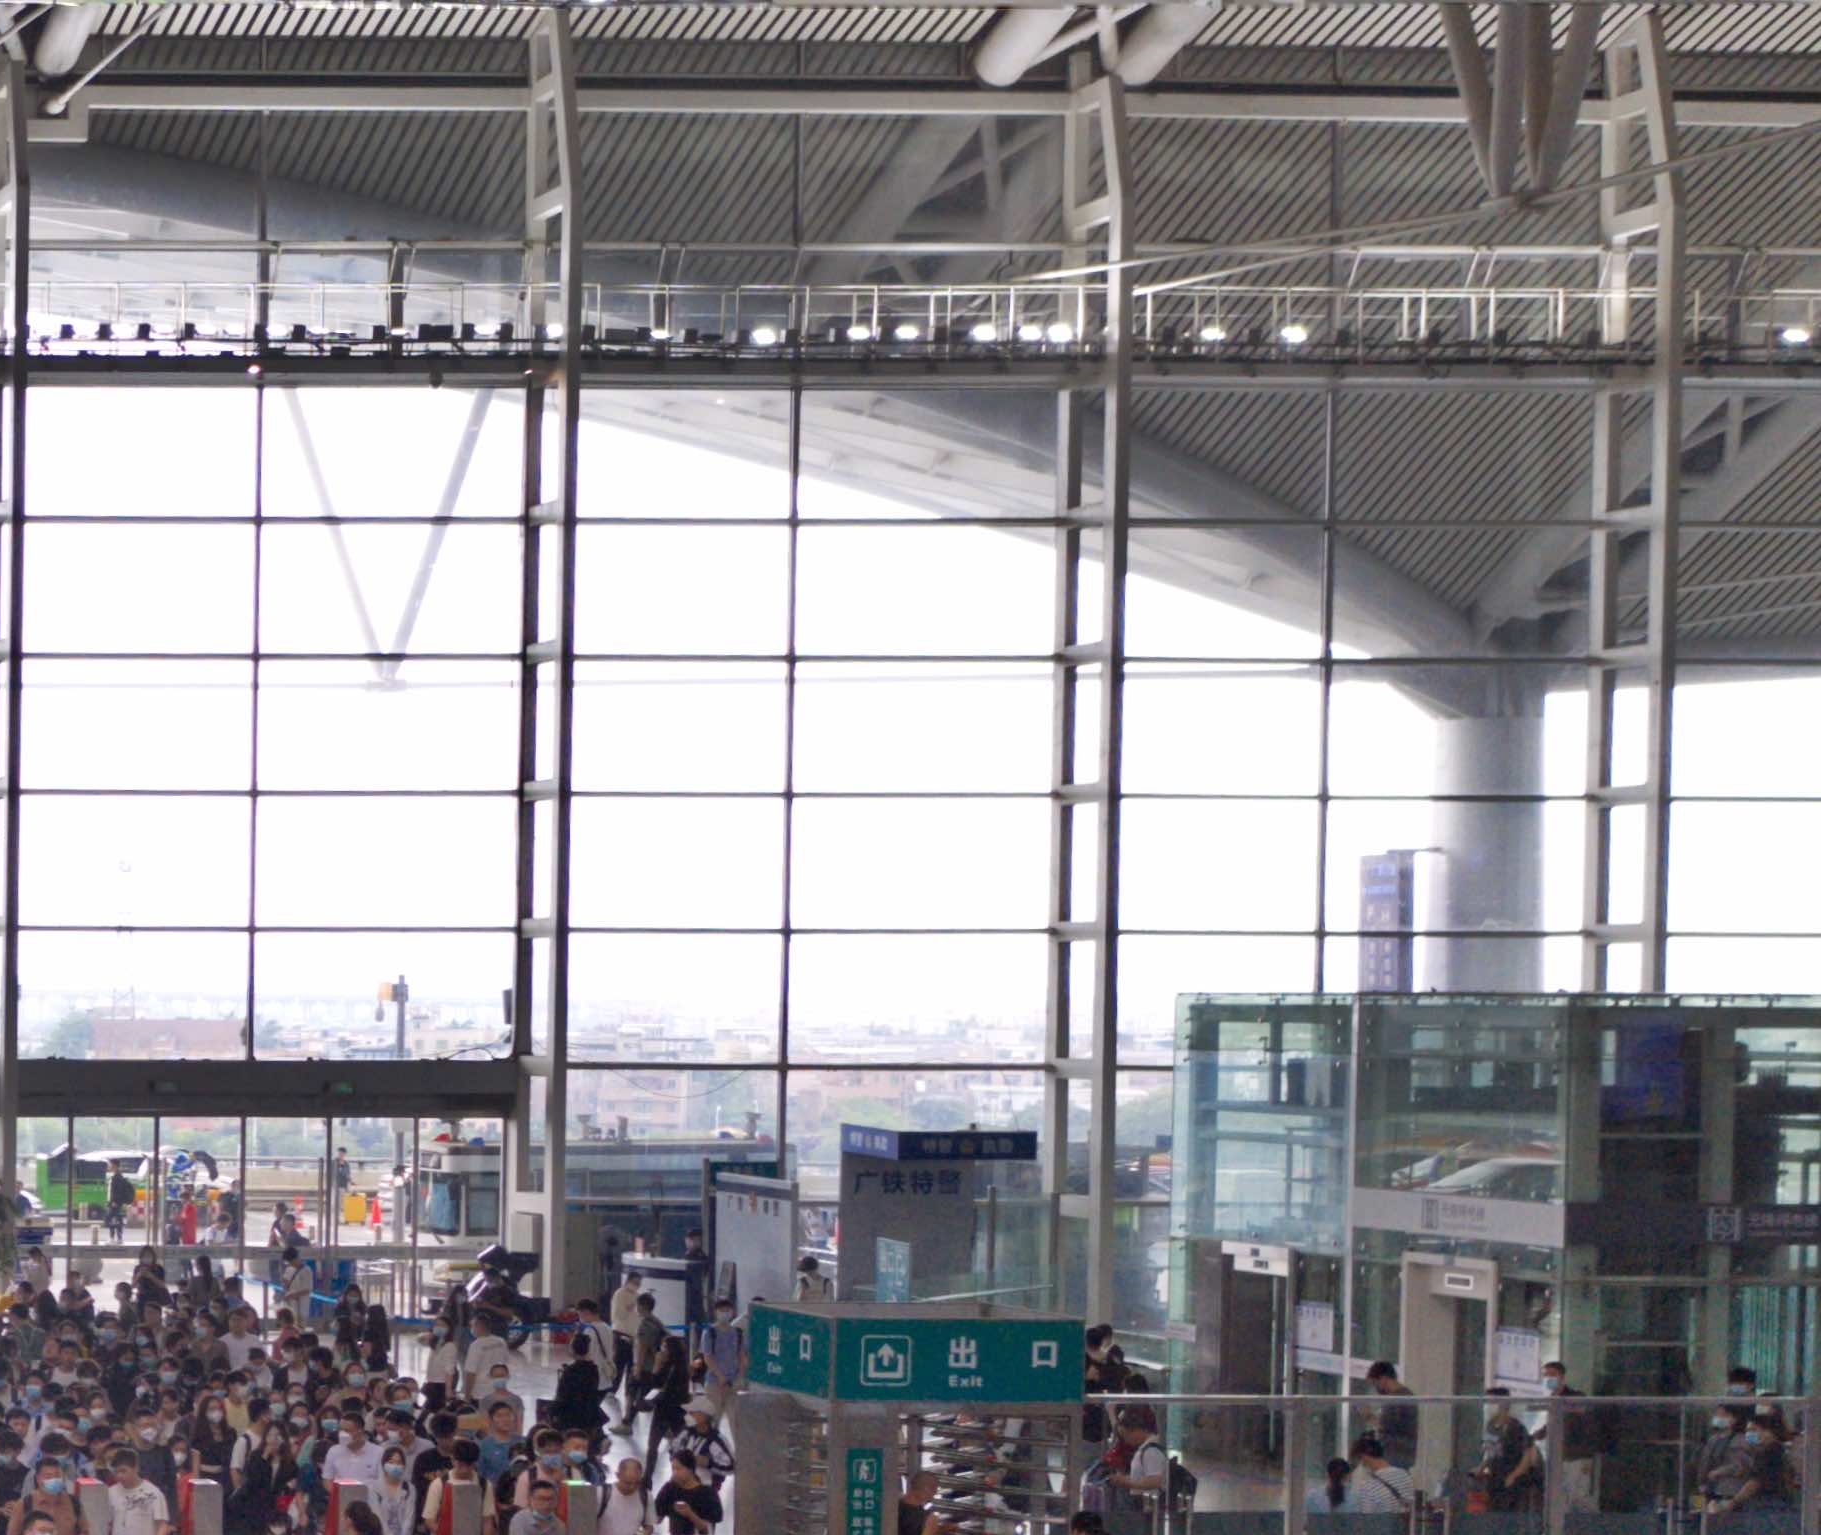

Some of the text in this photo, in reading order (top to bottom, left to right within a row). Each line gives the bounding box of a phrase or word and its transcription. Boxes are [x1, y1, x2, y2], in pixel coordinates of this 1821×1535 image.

[853, 1169, 962, 1196] 广铁特警
[767, 1325, 813, 1362] 出口
[948, 1336, 1059, 1369] 出口
[948, 1374, 984, 1389] Exit
